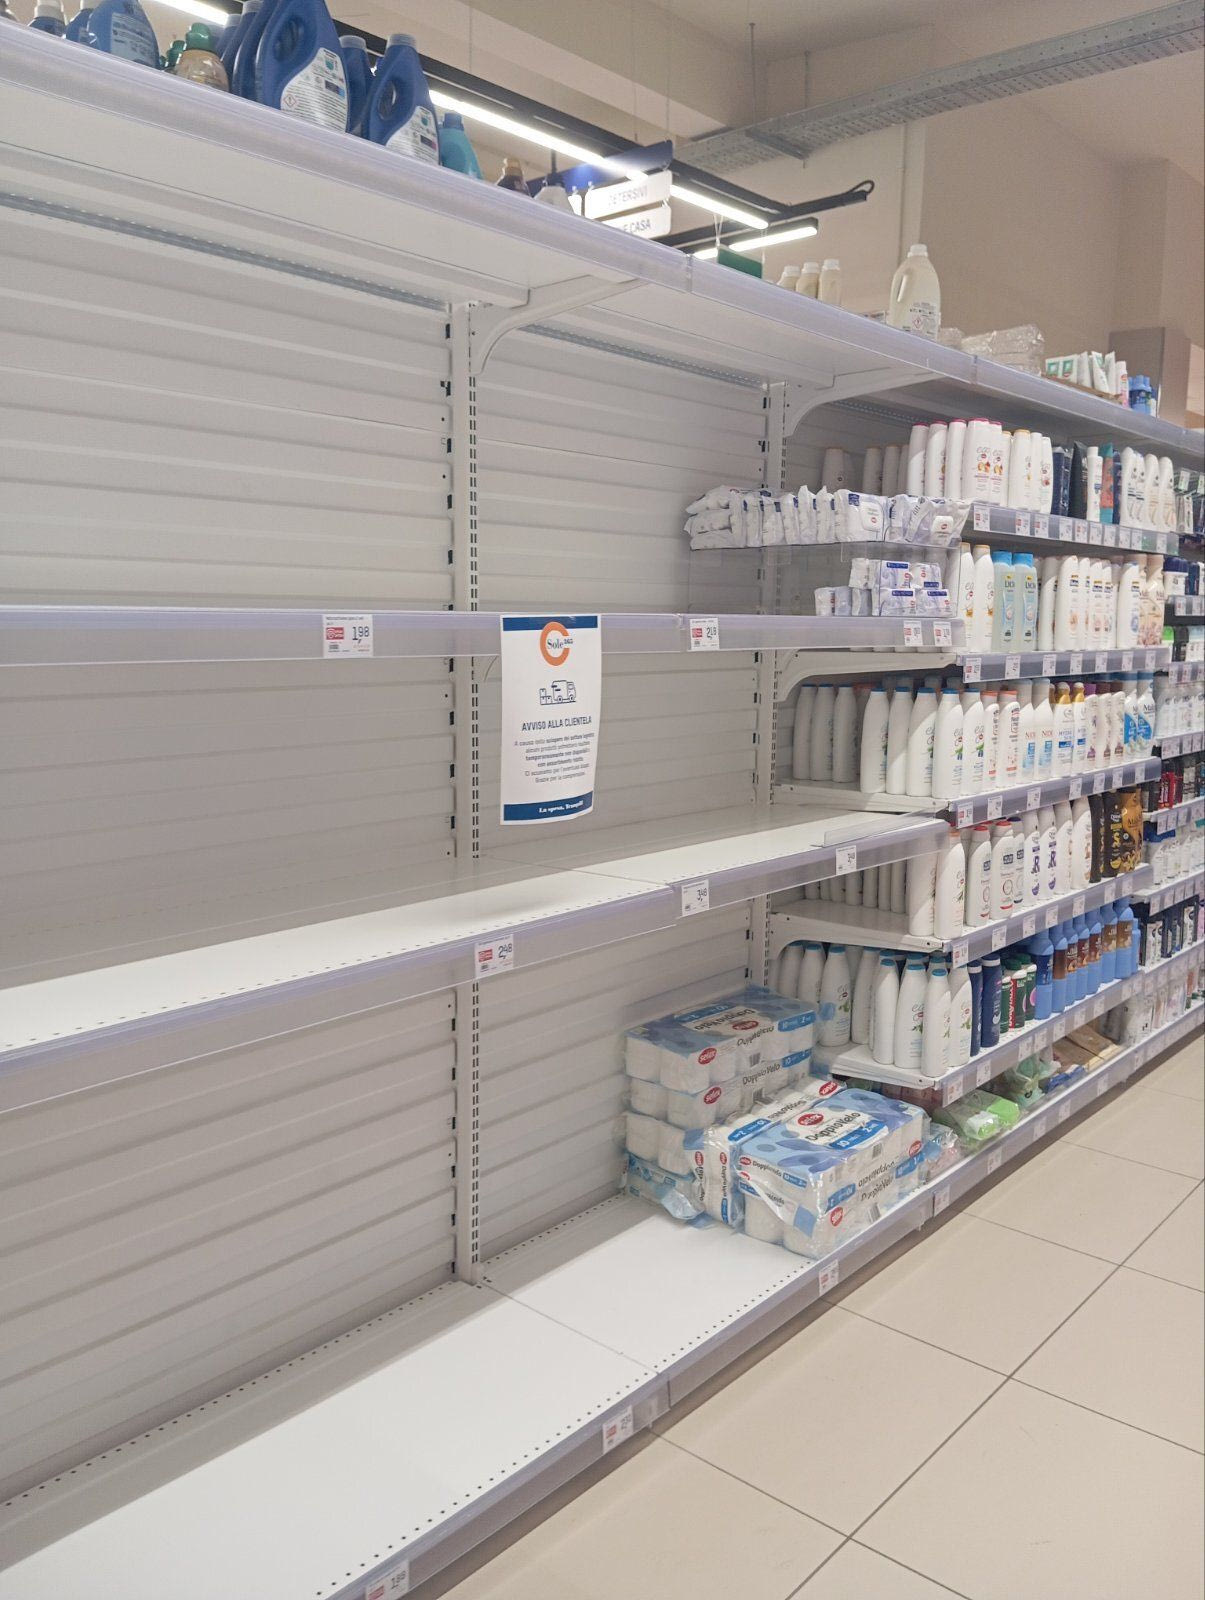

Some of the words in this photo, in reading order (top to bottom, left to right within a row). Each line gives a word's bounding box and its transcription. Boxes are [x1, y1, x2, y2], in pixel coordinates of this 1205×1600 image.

[546, 638, 564, 650] Sole
[522, 721, 546, 731] AVVISO
[548, 719, 563, 728] ALLA
[565, 716, 592, 726] CLIENTELA
[804, 1112, 861, 1141] DoppioVelo
